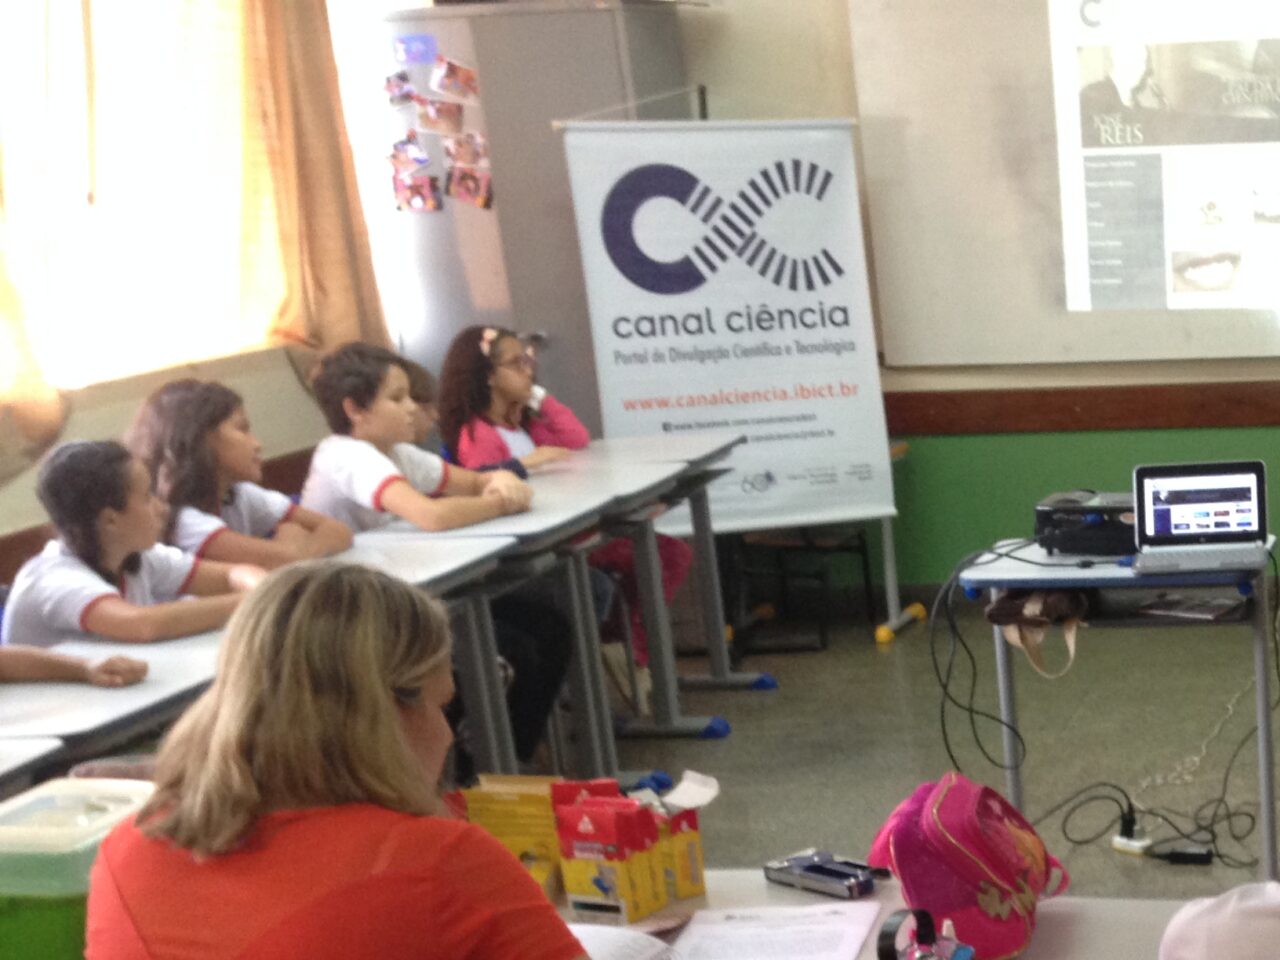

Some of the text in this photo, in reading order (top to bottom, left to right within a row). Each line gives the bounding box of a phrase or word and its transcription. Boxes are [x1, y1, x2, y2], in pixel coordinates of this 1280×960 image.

[1099, 123, 1144, 145] REIS
[612, 301, 850, 340] canal ciência
[613, 346, 649, 366] Portal
[651, 345, 666, 363] de
[622, 381, 859, 412] www.canalciencia.ibict.br
